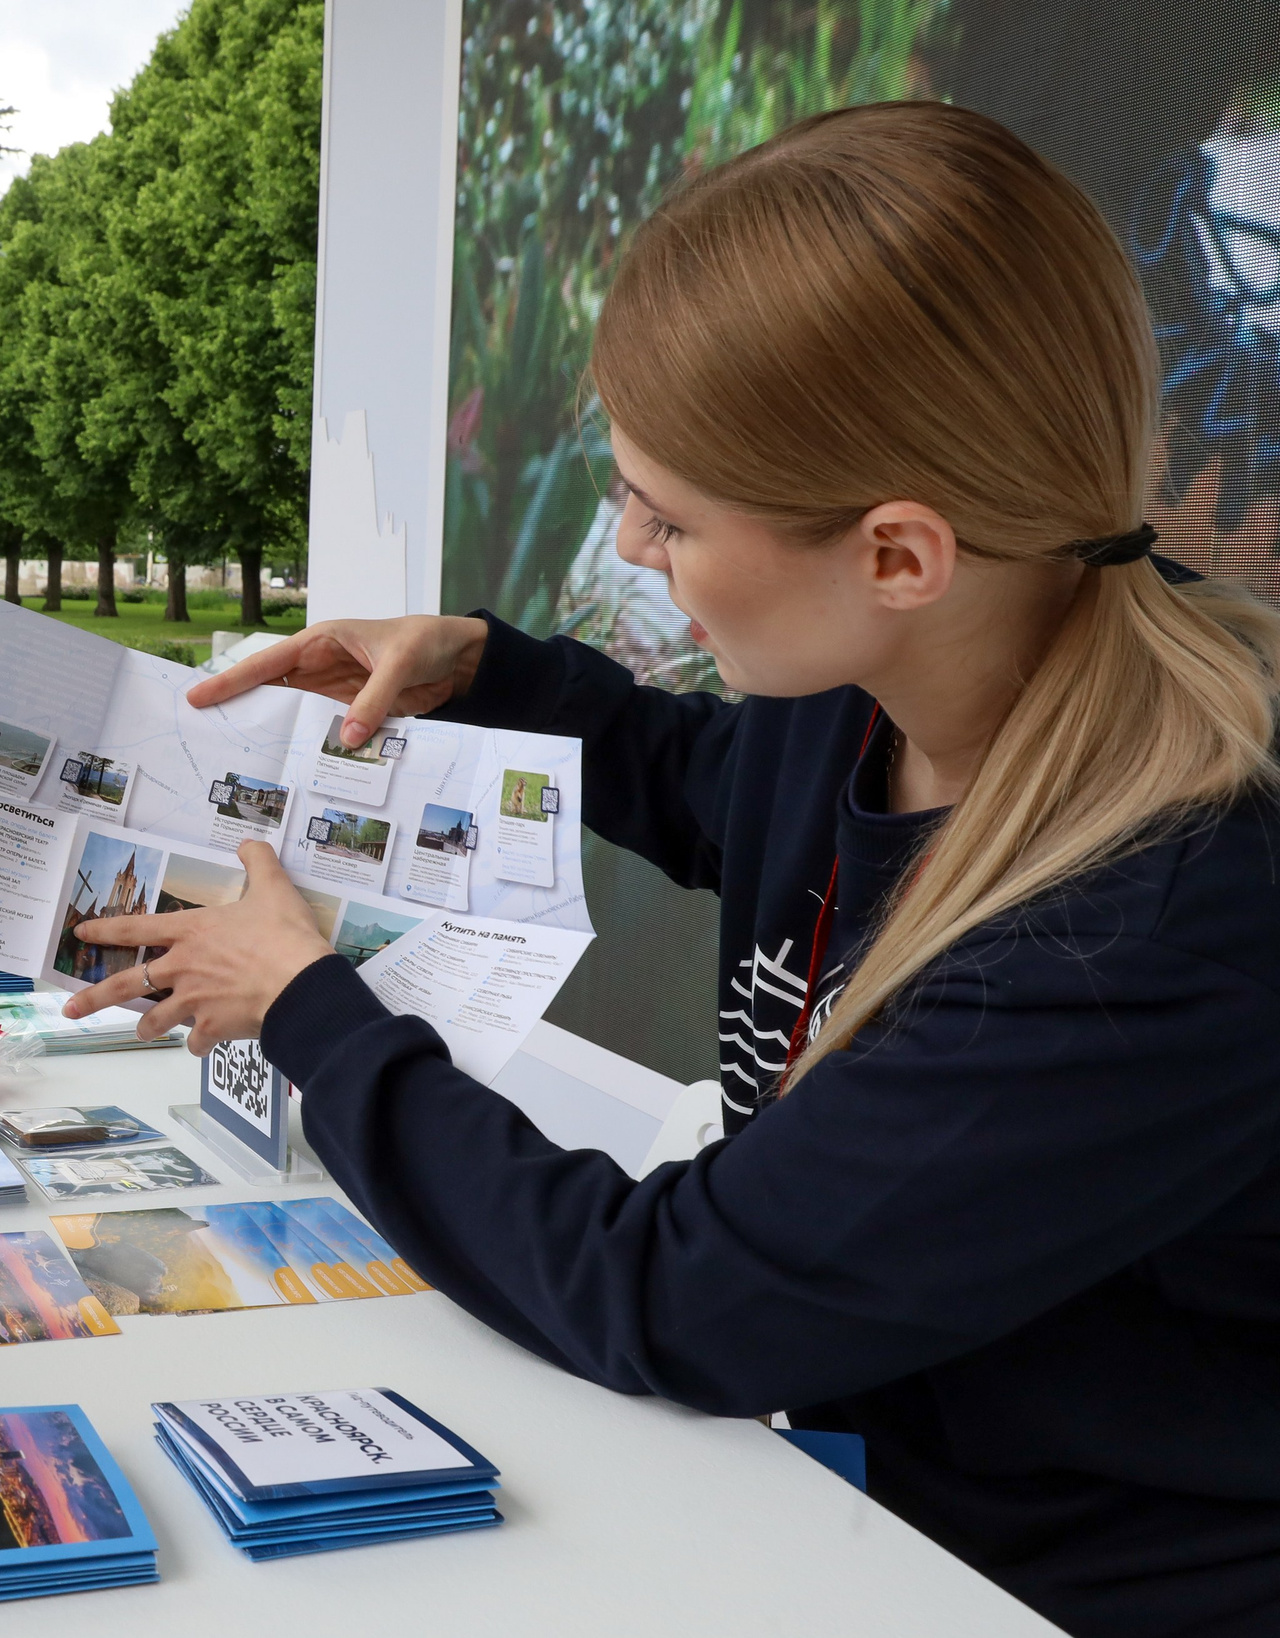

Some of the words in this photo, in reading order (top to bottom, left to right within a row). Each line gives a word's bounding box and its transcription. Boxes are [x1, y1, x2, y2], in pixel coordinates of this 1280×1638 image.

[180, 740, 198, 772] Высотная
[214, 816, 252, 831] Исторический
[6, 834, 28, 845] ПУШКИНА
[34, 837, 48, 846] ТЕАТР
[6, 848, 23, 858] ОПЕРЫ
[28, 856, 46, 866] БАЛЕТА
[412, 856, 446, 867] набережная
[414, 850, 450, 862] Центральная
[16, 911, 34, 920] МУЗЕЙ
[441, 921, 476, 937] Купить
[491, 932, 527, 944] память
[402, 956, 416, 967] ДАРЫ
[416, 965, 434, 976] СЕВЕРА
[387, 966, 418, 988] СУВЕНИРНЫЕ
[418, 986, 432, 996] ИЗБЫ
[391, 975, 412, 991] СТОЛБАХ
[476, 988, 500, 997] СЕВЕРНАЯ
[200, 1402, 264, 1444] РОССИИ
[234, 1400, 293, 1439] СЕРДЦЕ
[264, 1397, 278, 1405] В
[274, 1404, 336, 1444] САМОМ
[346, 1391, 415, 1442] Гид-путеводитель
[296, 1395, 394, 1465] КРАСНОЯРСК.
